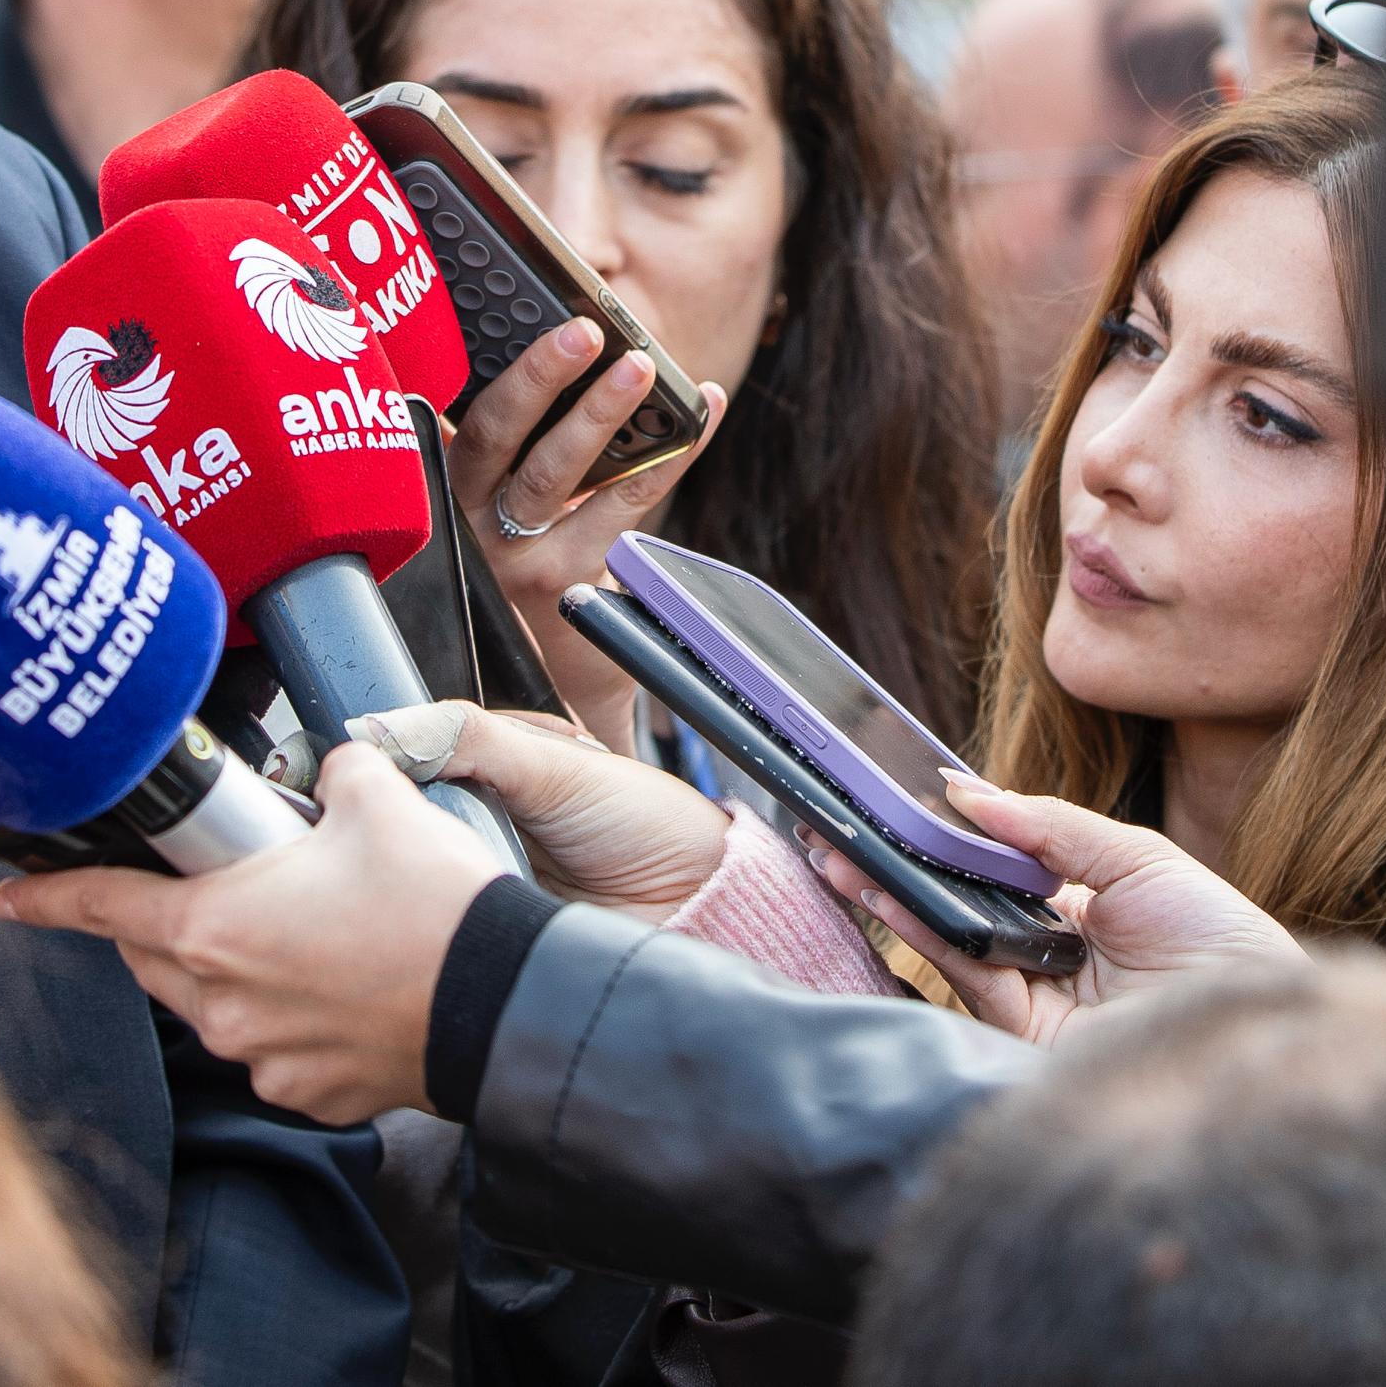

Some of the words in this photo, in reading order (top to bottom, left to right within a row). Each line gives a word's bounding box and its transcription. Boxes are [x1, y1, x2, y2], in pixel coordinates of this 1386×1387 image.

[279, 366, 415, 436] anka
[129, 427, 242, 518] nka
[289, 431, 363, 457] HABER
[174, 460, 252, 527] AJANSI
[12, 529, 100, 642] İZMİR
[47, 536, 176, 740] BELEDİYESİ
